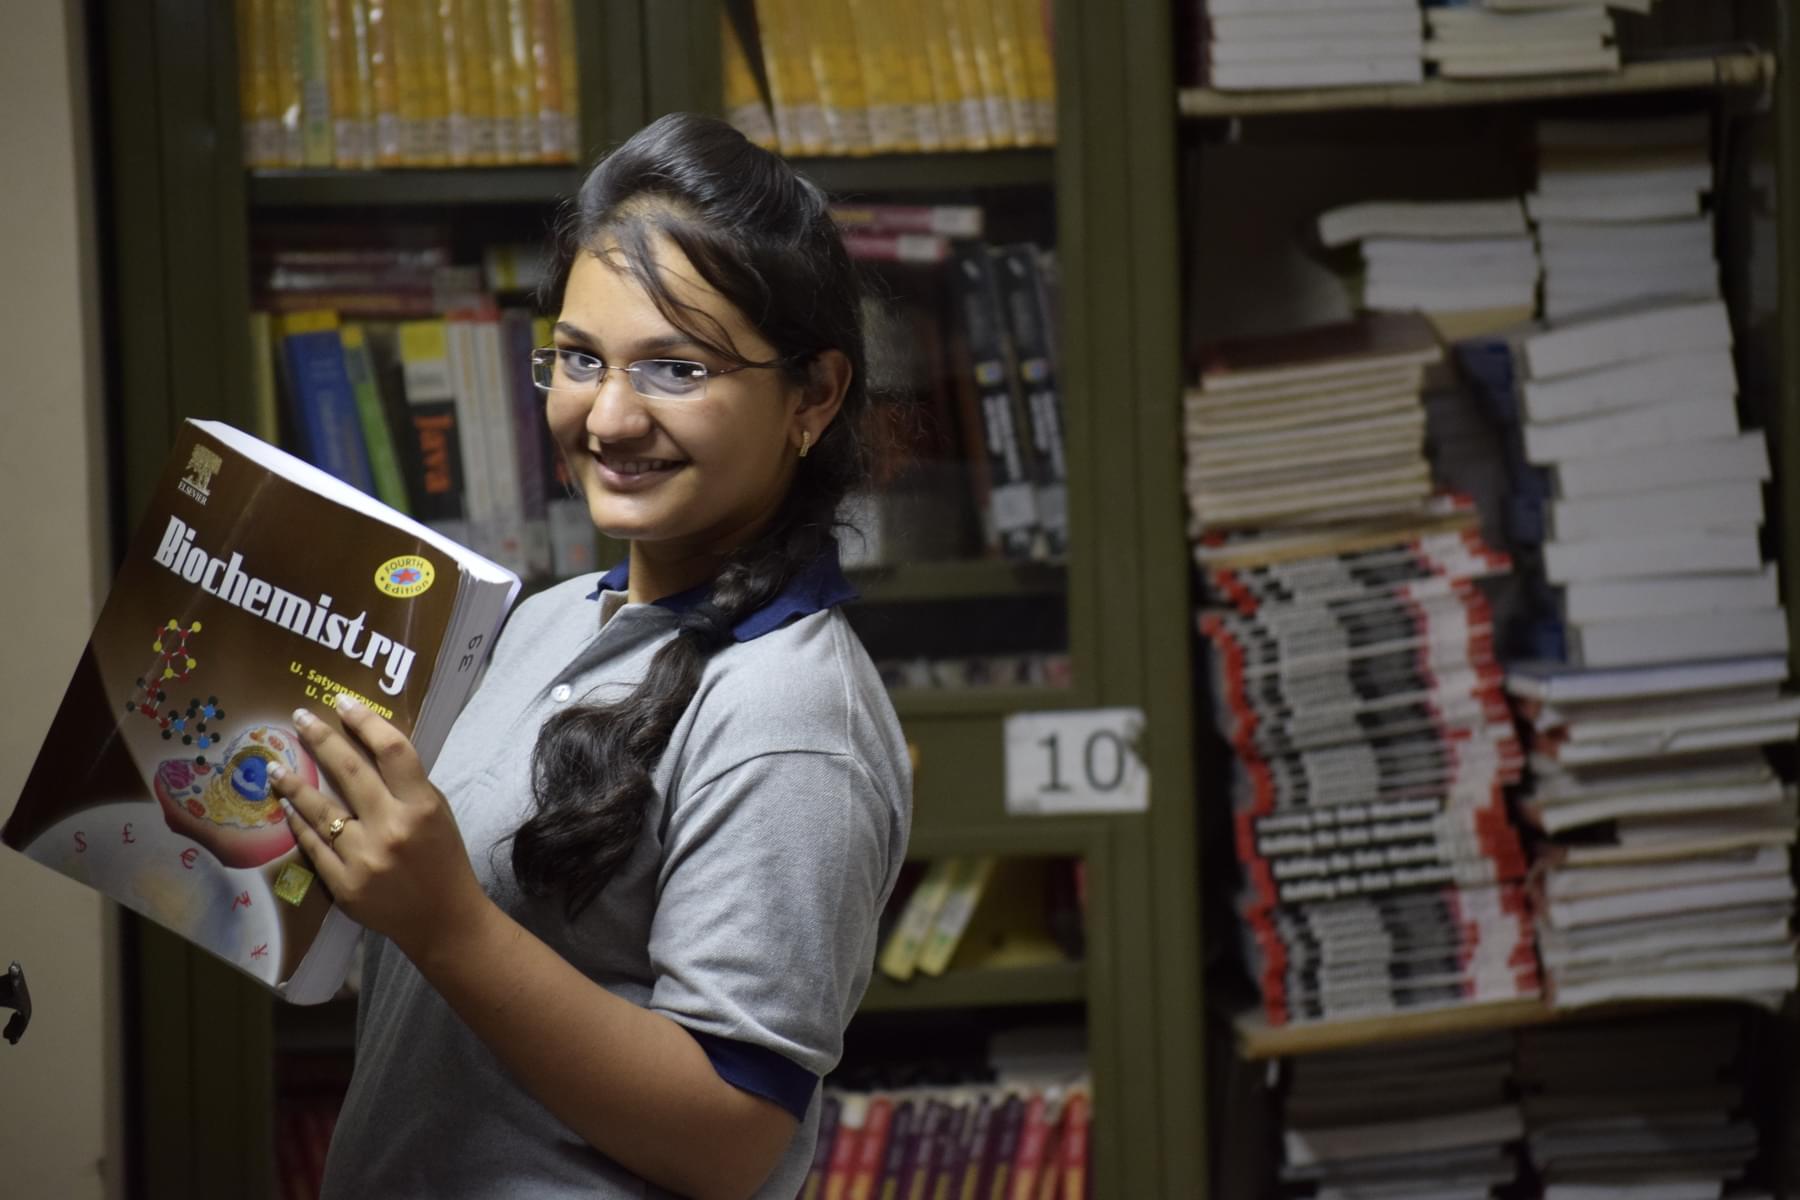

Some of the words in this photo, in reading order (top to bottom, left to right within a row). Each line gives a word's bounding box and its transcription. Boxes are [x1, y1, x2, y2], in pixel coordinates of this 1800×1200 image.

[177, 480, 208, 506] ELSEVIER
[384, 558, 425, 574] FOURTH
[384, 580, 429, 595] Edition
[153, 514, 417, 696] Biochemistry
[457, 634, 483, 673] 39
[290, 661, 304, 676] U.
[304, 684, 318, 700] U.
[1037, 728, 1126, 795] 10
